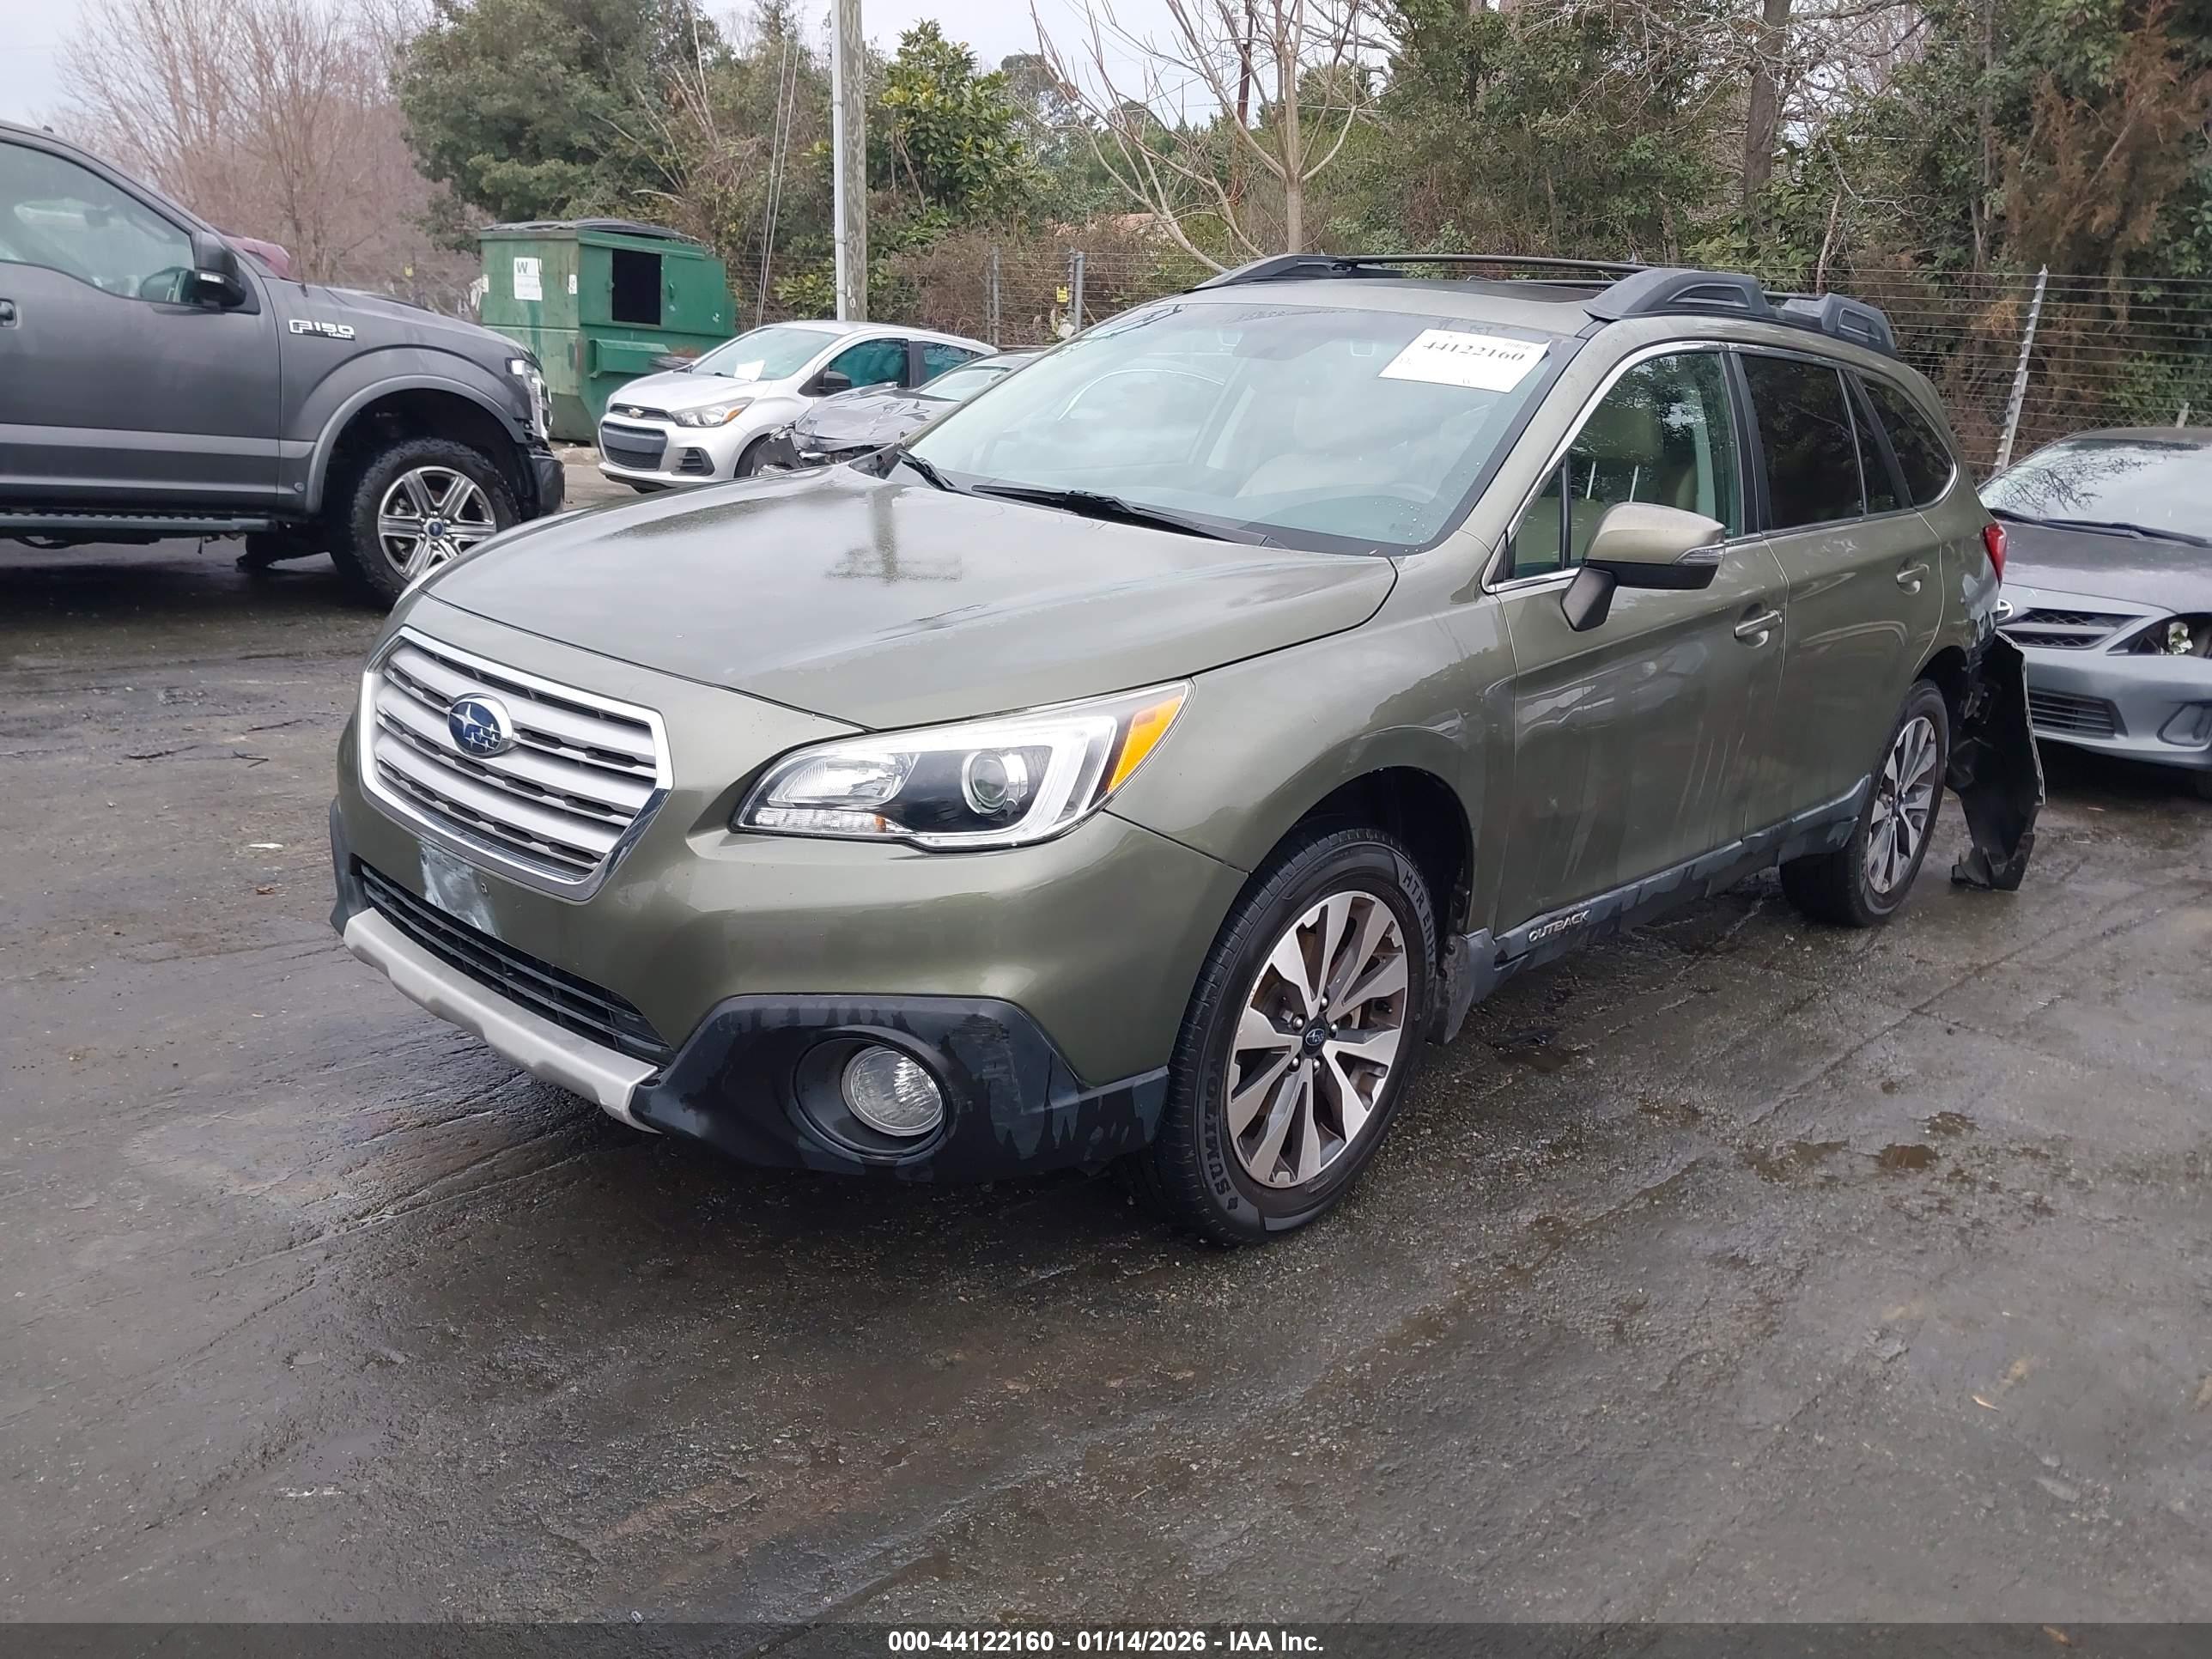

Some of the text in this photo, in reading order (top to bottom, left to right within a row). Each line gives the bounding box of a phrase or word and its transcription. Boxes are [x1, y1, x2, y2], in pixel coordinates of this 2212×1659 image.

[516, 261, 528, 274] W
[1423, 342, 1525, 362] 44122160
[1402, 870, 1425, 910] HTR
[1528, 909, 1590, 942] OUTBACK
